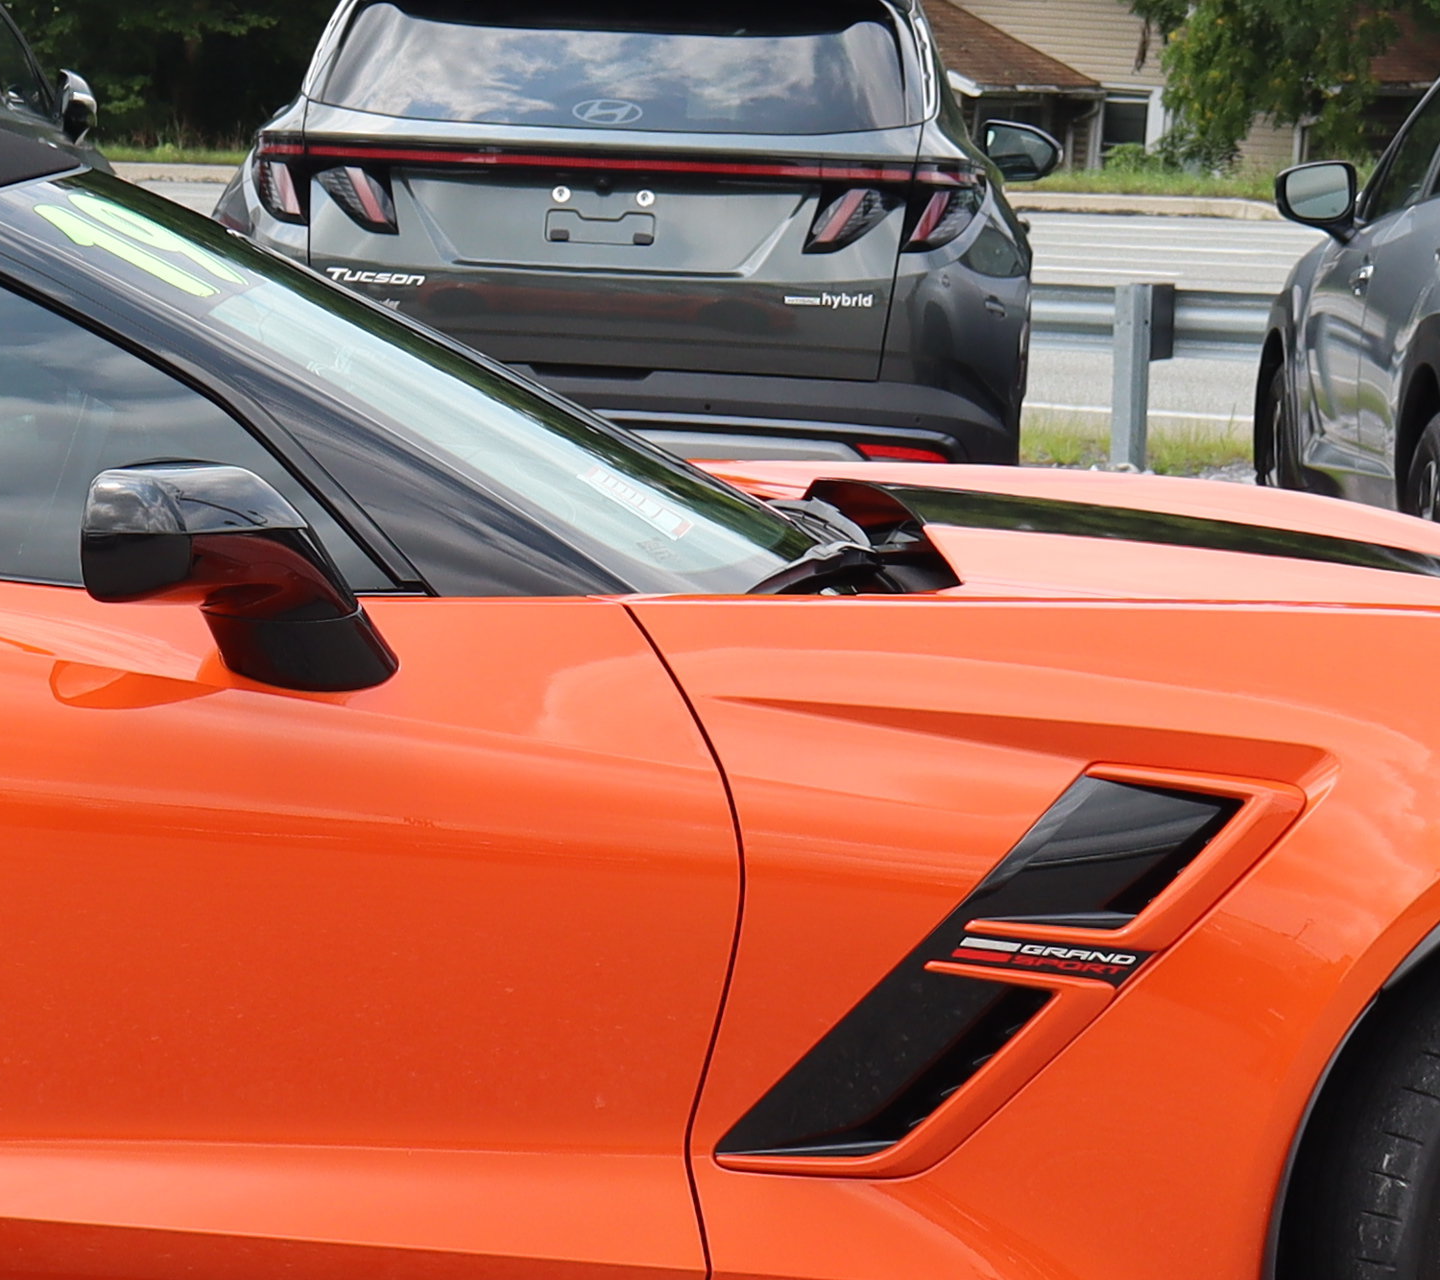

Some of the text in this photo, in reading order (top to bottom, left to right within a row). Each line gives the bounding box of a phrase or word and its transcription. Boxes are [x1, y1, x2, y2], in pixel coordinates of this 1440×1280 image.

[822, 292, 873, 309] hybrid
[1020, 944, 1137, 965] GRAND
[1012, 955, 1128, 975] SPORT
